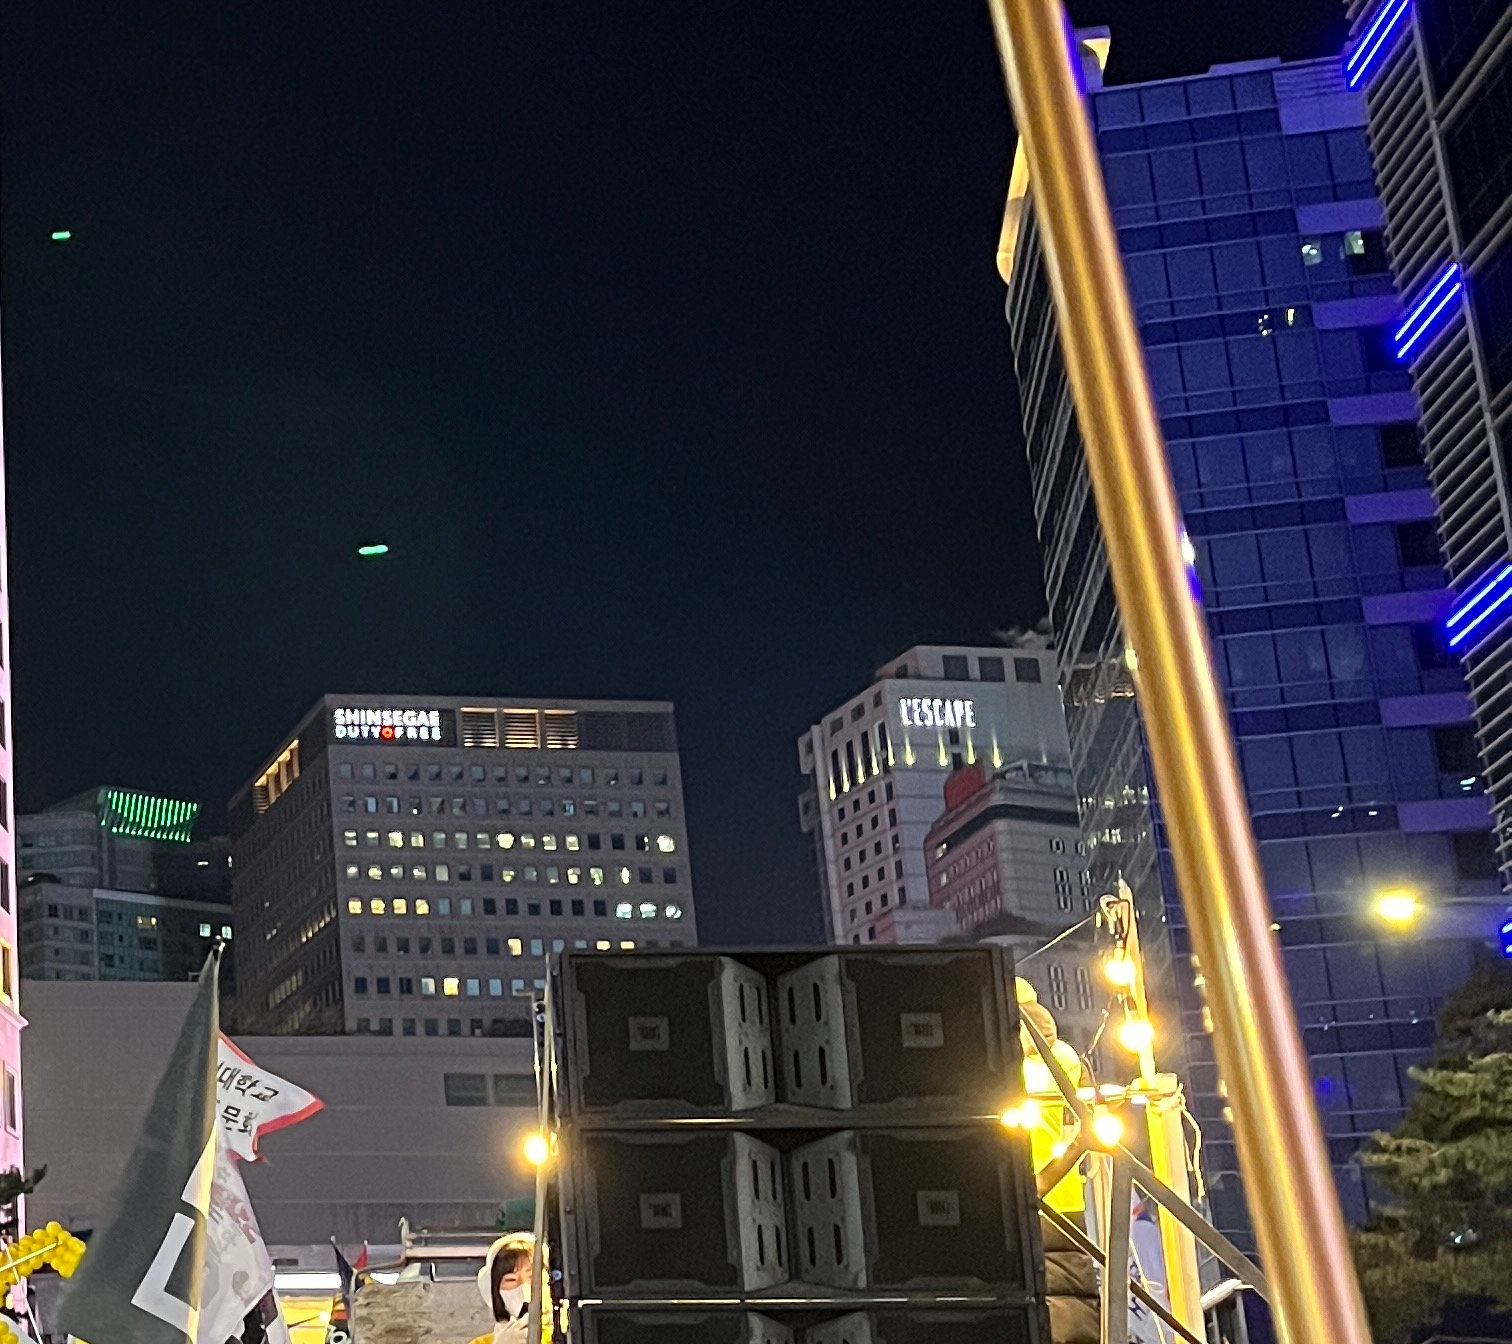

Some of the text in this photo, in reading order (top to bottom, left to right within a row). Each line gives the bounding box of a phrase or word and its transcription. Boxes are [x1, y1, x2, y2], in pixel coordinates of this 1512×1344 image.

[333, 707, 440, 727] SHINSEGAE
[900, 698, 977, 728] L'ESCAPE
[335, 725, 442, 741] DUTY FREE
[218, 1061, 279, 1103] 대학교
[221, 1104, 259, 1137] 문회
